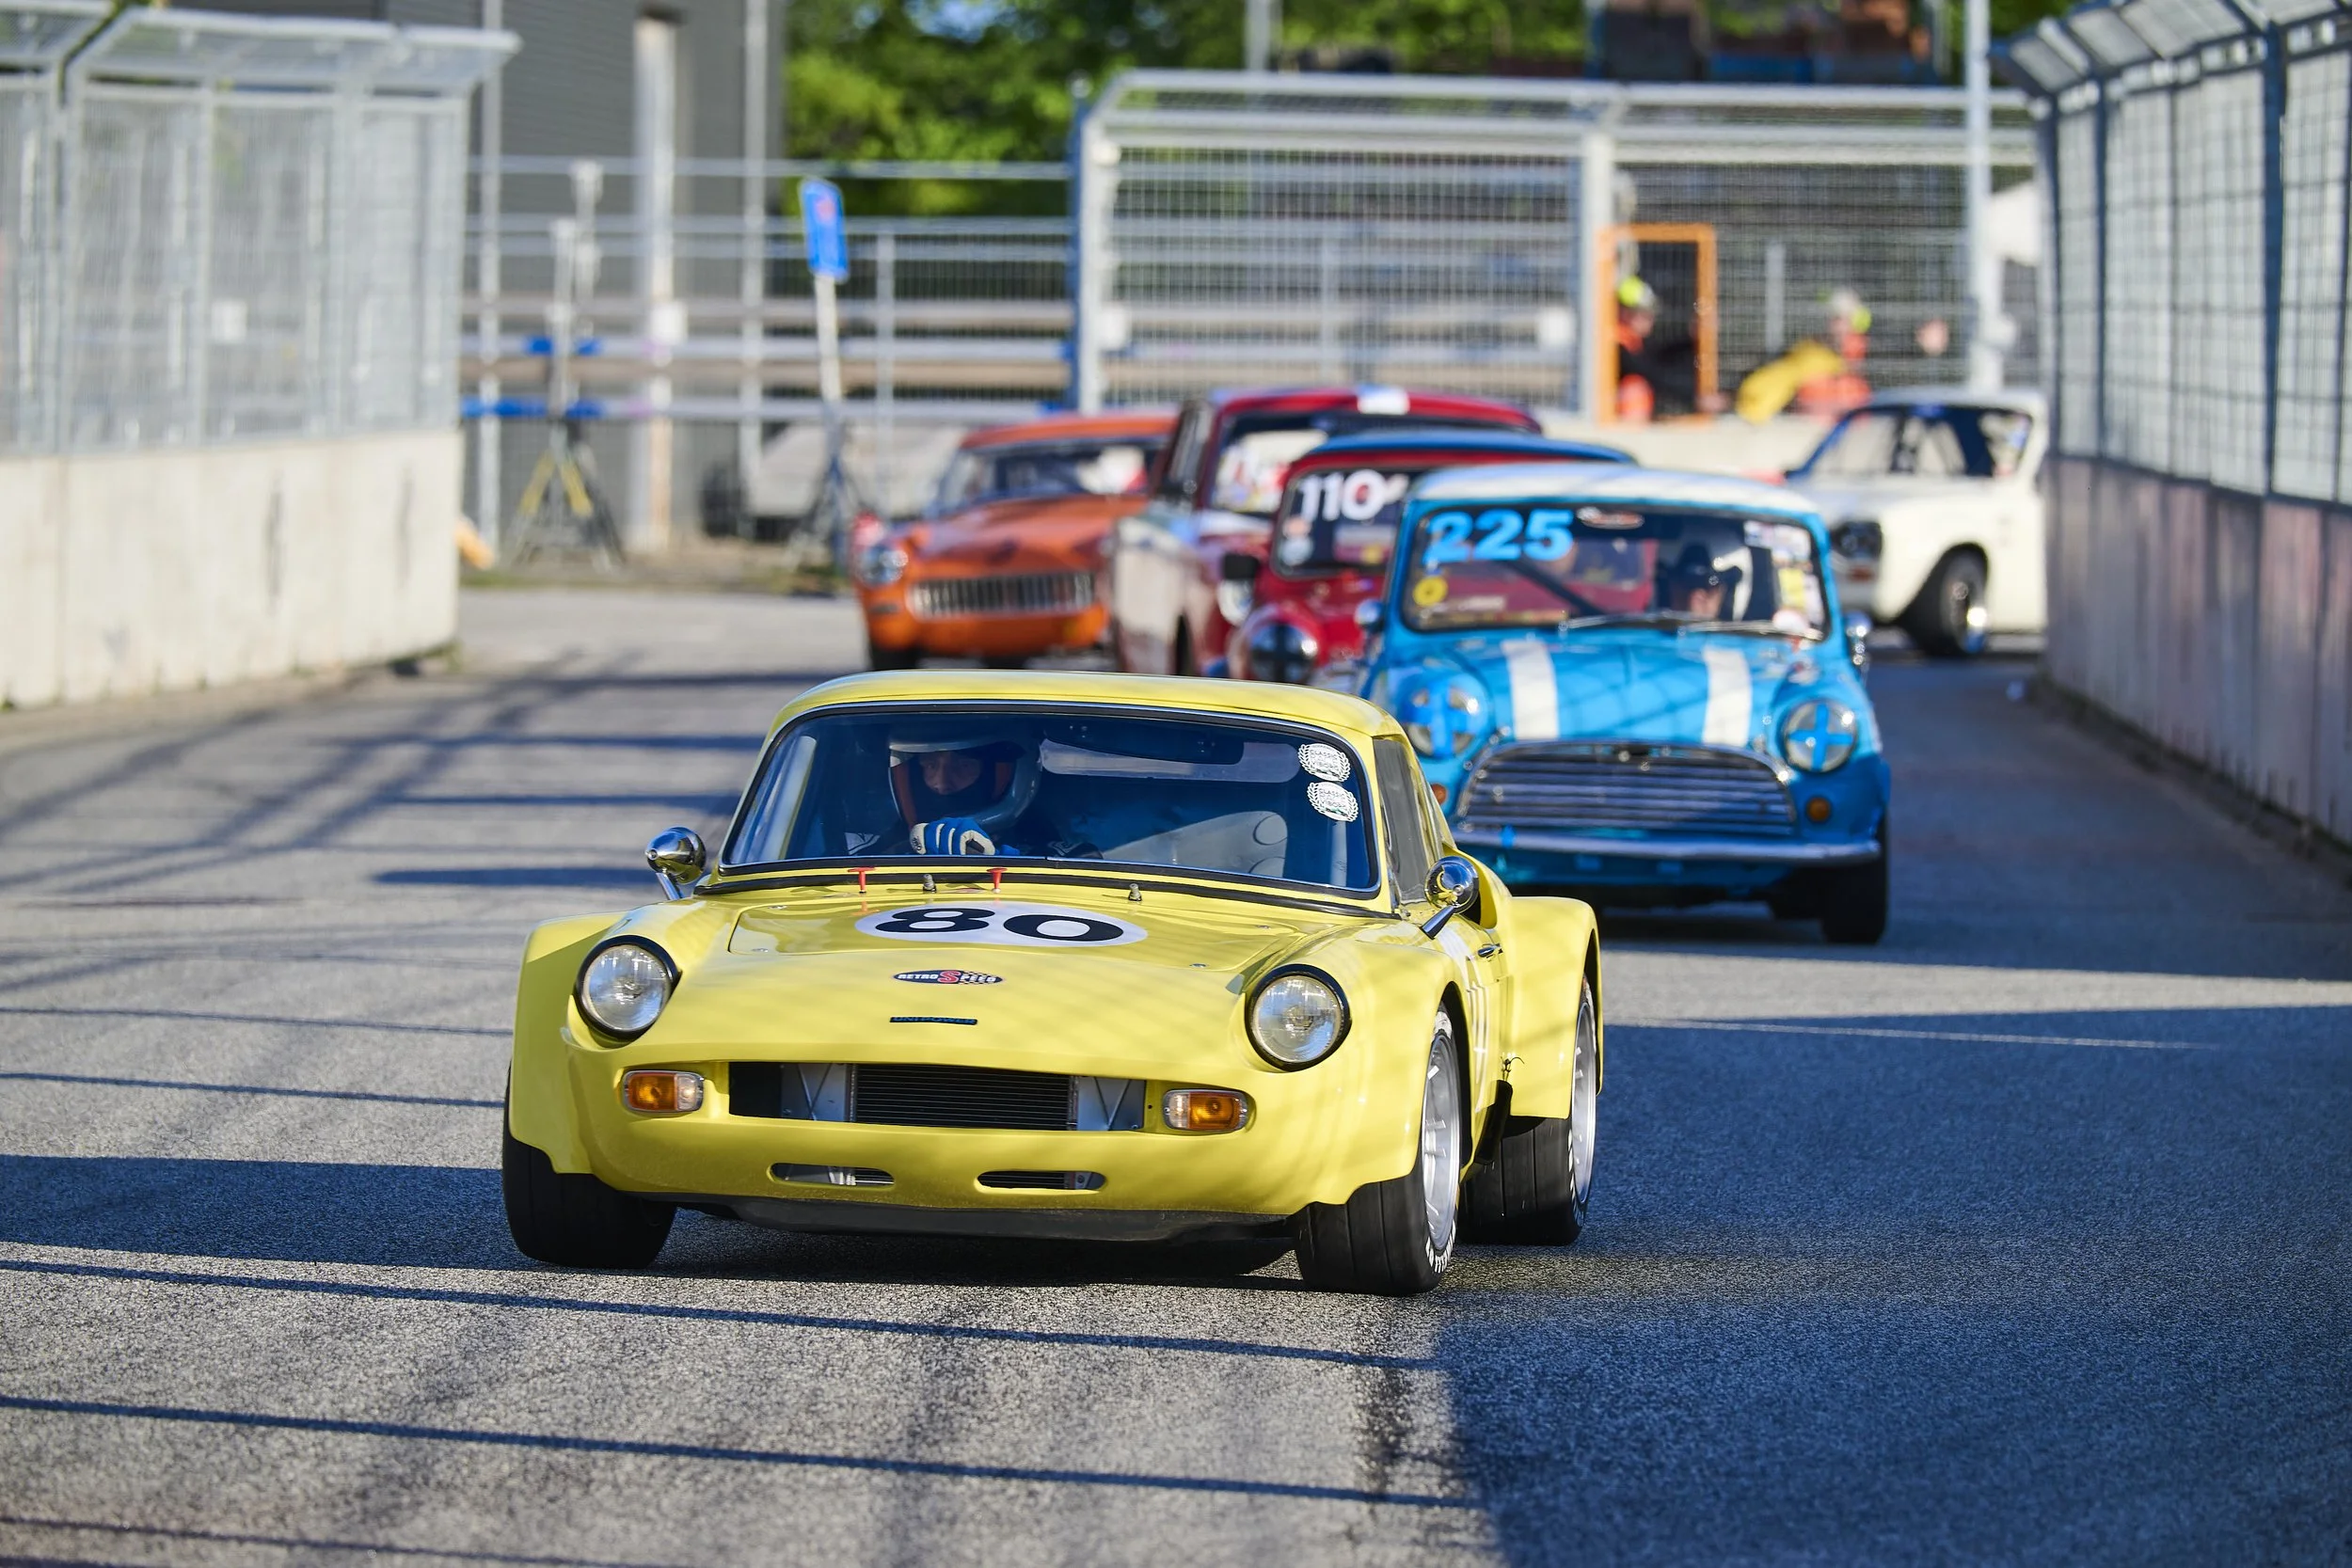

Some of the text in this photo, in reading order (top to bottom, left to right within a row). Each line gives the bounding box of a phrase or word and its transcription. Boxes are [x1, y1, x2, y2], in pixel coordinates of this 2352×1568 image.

[1298, 469, 1387, 521] 110
[1422, 508, 1574, 563] 225
[875, 907, 1124, 942] 80
